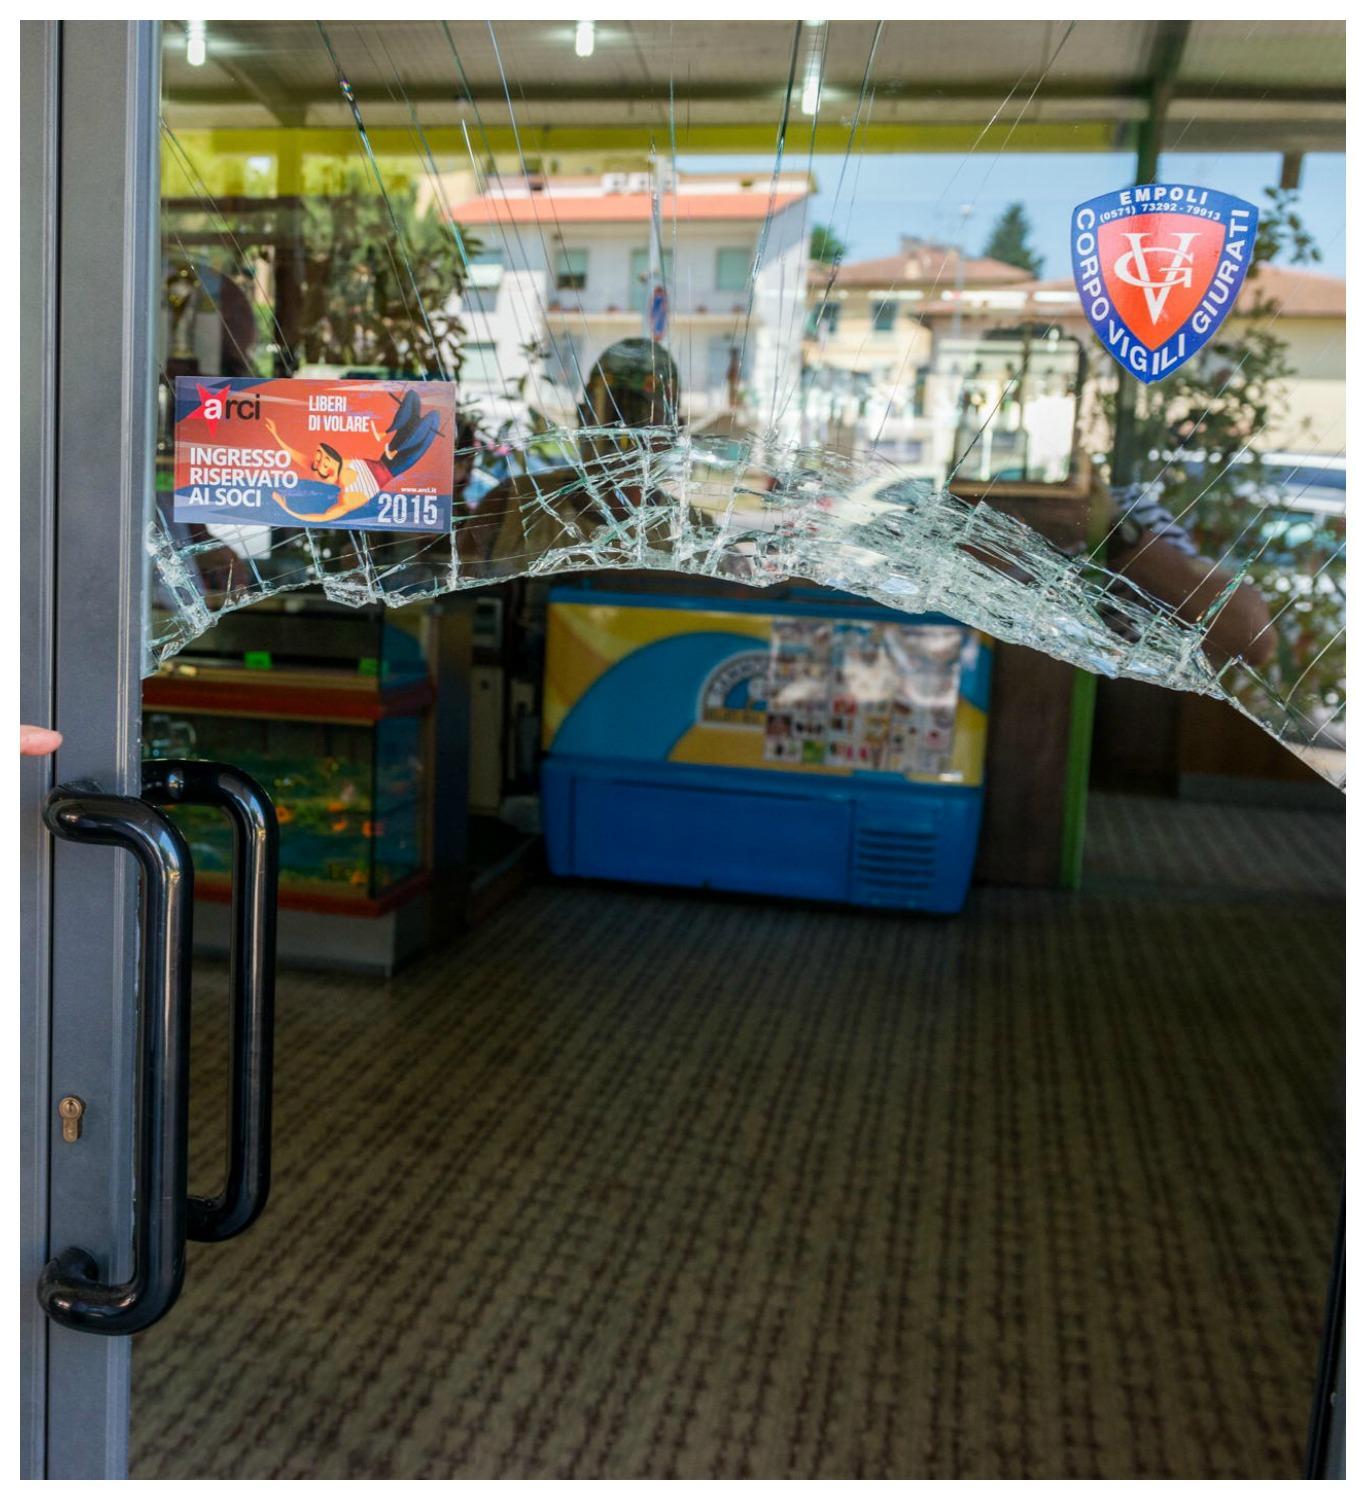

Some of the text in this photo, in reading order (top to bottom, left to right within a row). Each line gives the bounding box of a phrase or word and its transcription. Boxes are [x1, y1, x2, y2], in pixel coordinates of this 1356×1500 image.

[1119, 187, 1208, 206] EMPOLI
[1099, 205, 1136, 223] (0571)
[1141, 202, 1177, 213] 73292
[1186, 204, 1221, 221] 79913
[1076, 208, 1250, 375] CORPO VIGILI GIURATI
[203, 394, 261, 420] arci
[308, 395, 347, 412] LIBERI
[308, 414, 370, 433] DI VOLARE
[189, 447, 292, 468] INGRESSO
[189, 467, 299, 489] RISERVATO
[189, 487, 262, 507] AI SOCI
[377, 493, 439, 525] 2015
